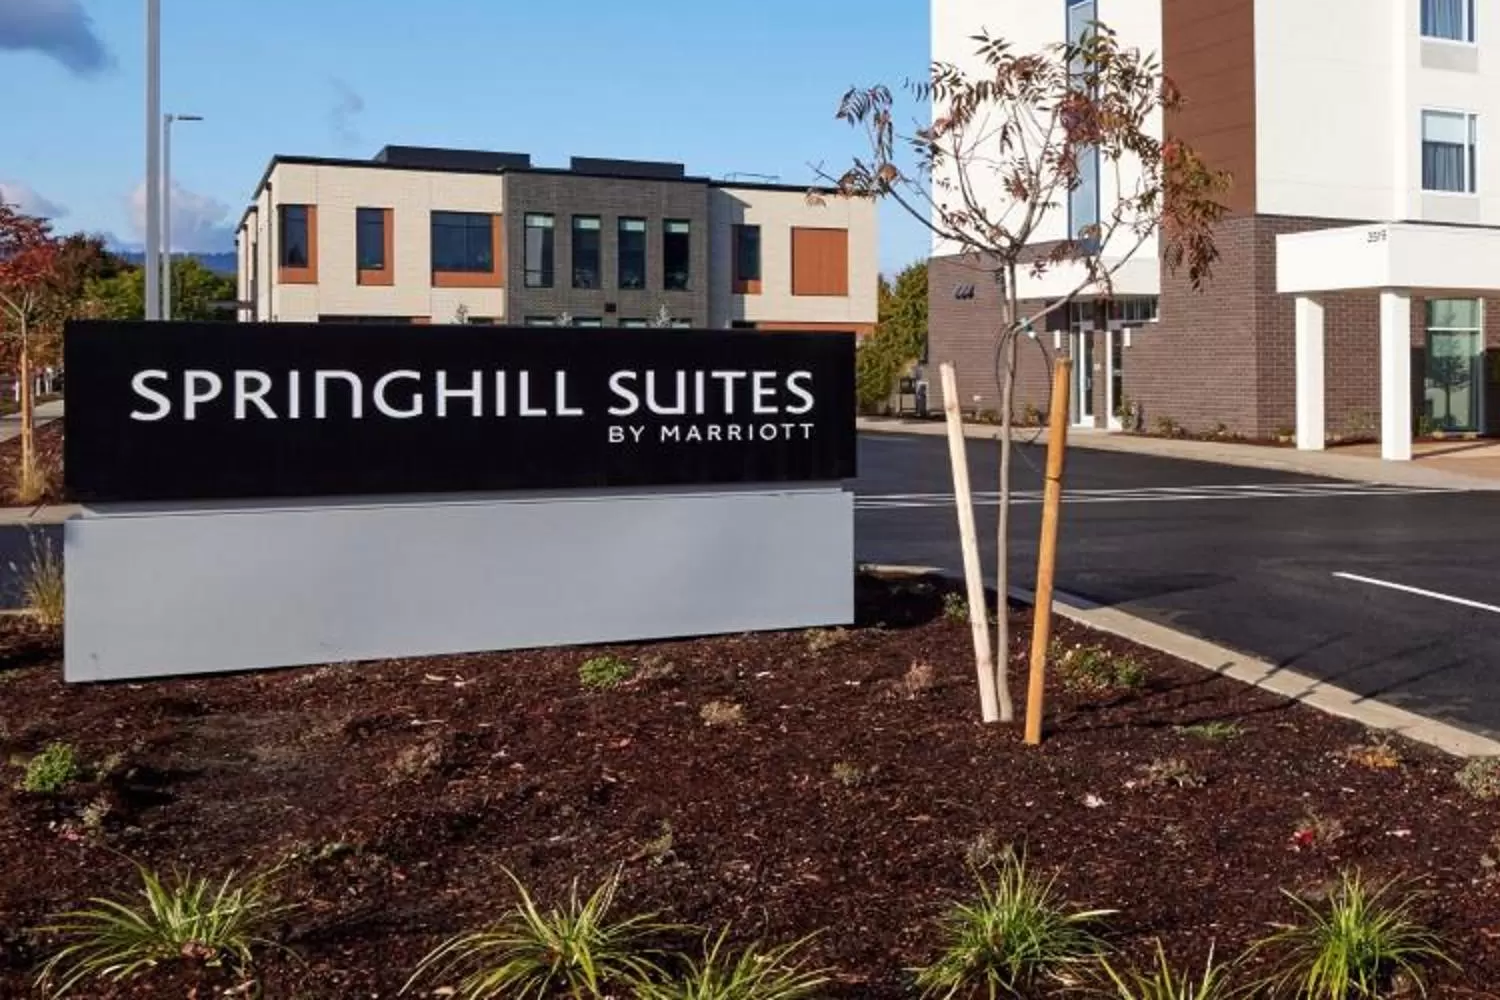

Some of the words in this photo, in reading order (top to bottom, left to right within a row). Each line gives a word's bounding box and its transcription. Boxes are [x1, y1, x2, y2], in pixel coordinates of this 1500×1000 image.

[130, 369, 584, 421] SPRINGHILL
[607, 370, 814, 416] SUITES
[608, 425, 645, 443] BY
[661, 423, 814, 442] MARRIOTT
